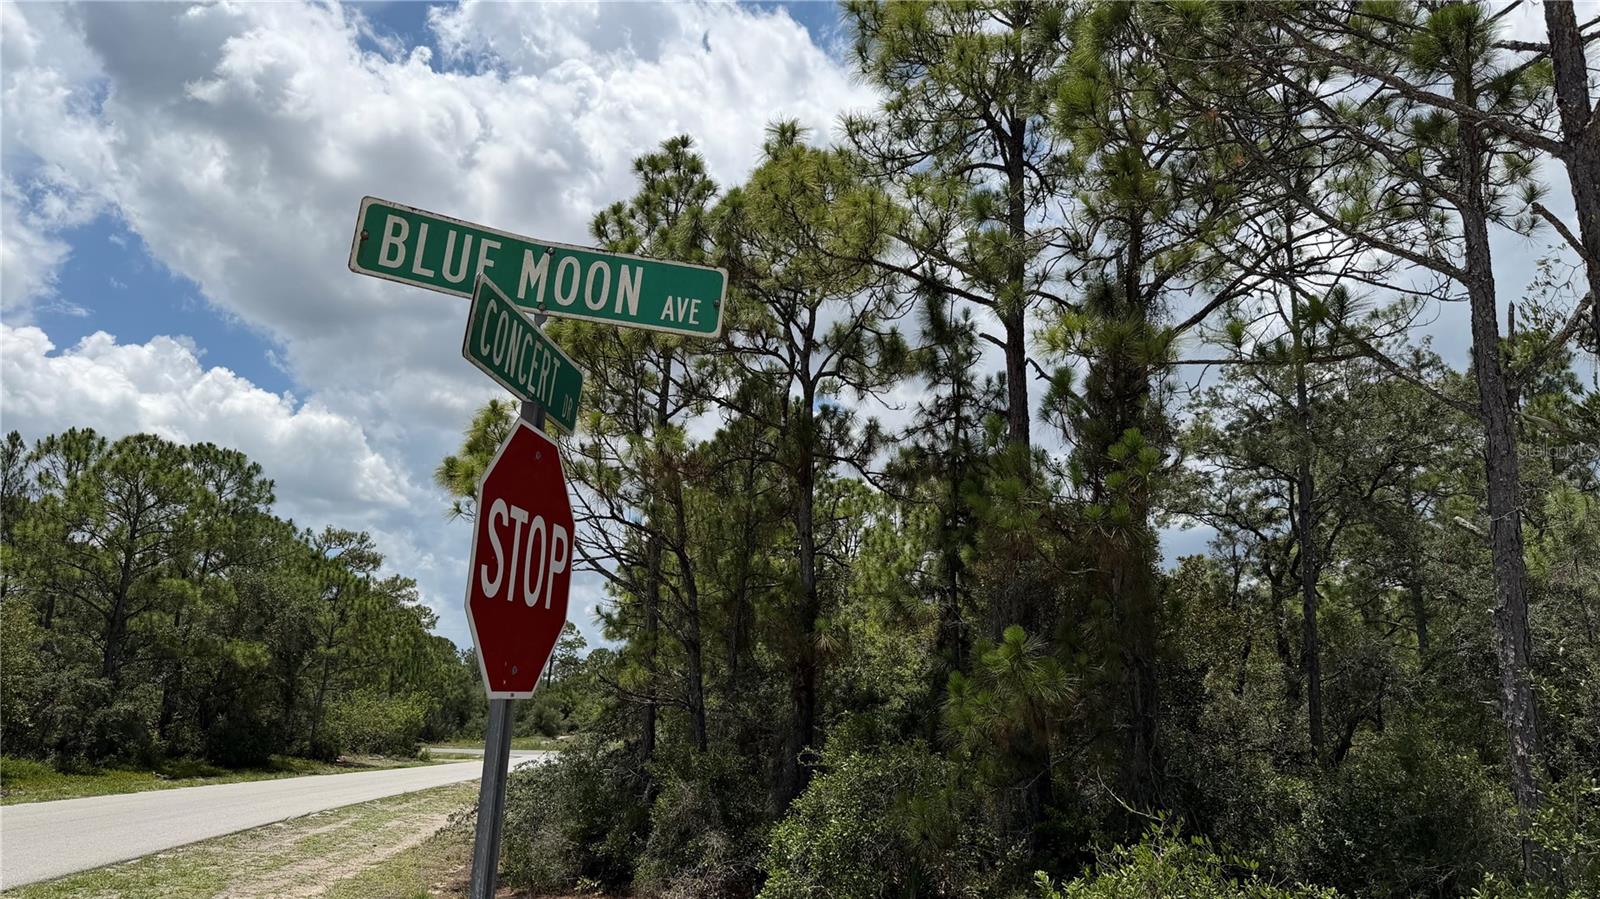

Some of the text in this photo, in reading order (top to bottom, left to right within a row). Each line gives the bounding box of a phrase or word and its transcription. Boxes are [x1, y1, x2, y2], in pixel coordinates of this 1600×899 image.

[378, 213, 702, 325] BLUE MOON AVE
[480, 299, 573, 421] CONCERT DR
[481, 498, 568, 609] STOP
